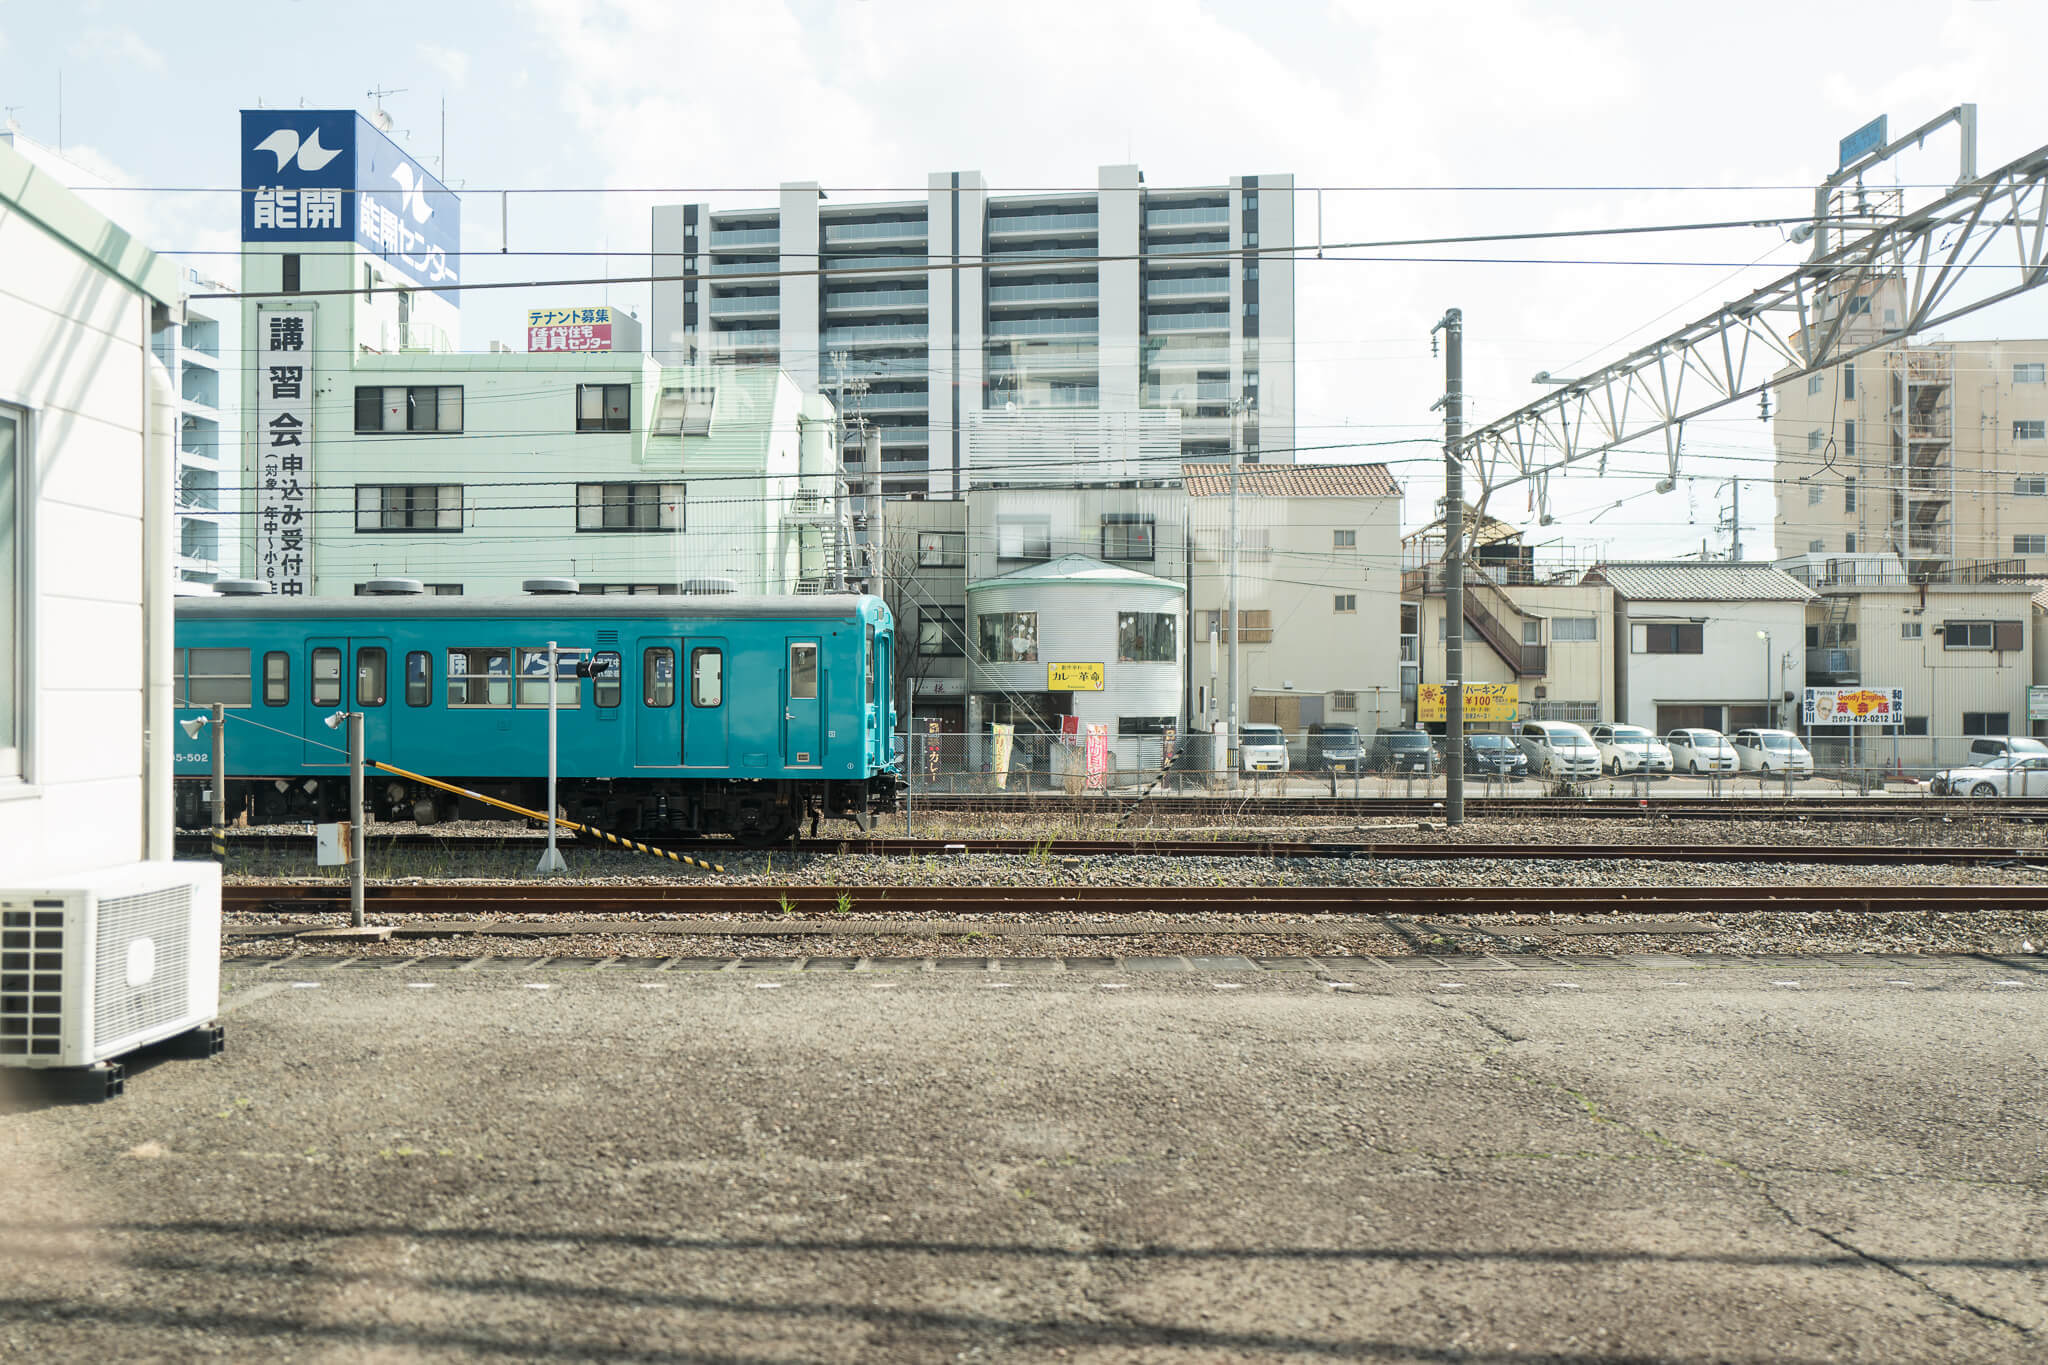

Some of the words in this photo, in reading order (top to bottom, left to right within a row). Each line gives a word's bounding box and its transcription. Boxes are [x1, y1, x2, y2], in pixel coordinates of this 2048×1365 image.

[254, 186, 342, 229] 能開
[360, 191, 458, 282] 能開センター
[530, 309, 609, 325] テナント募集
[530, 327, 569, 351] 賃貸
[568, 326, 593, 338] 住宅
[568, 338, 611, 349] センター
[269, 317, 304, 446] 講習会
[281, 453, 303, 597] 申込み受付中
[1838, 690, 1860, 703] Goody
[1861, 690, 1887, 701] English
[1837, 702, 1889, 713] 英会話
[174, 753, 208, 762] 5-502
